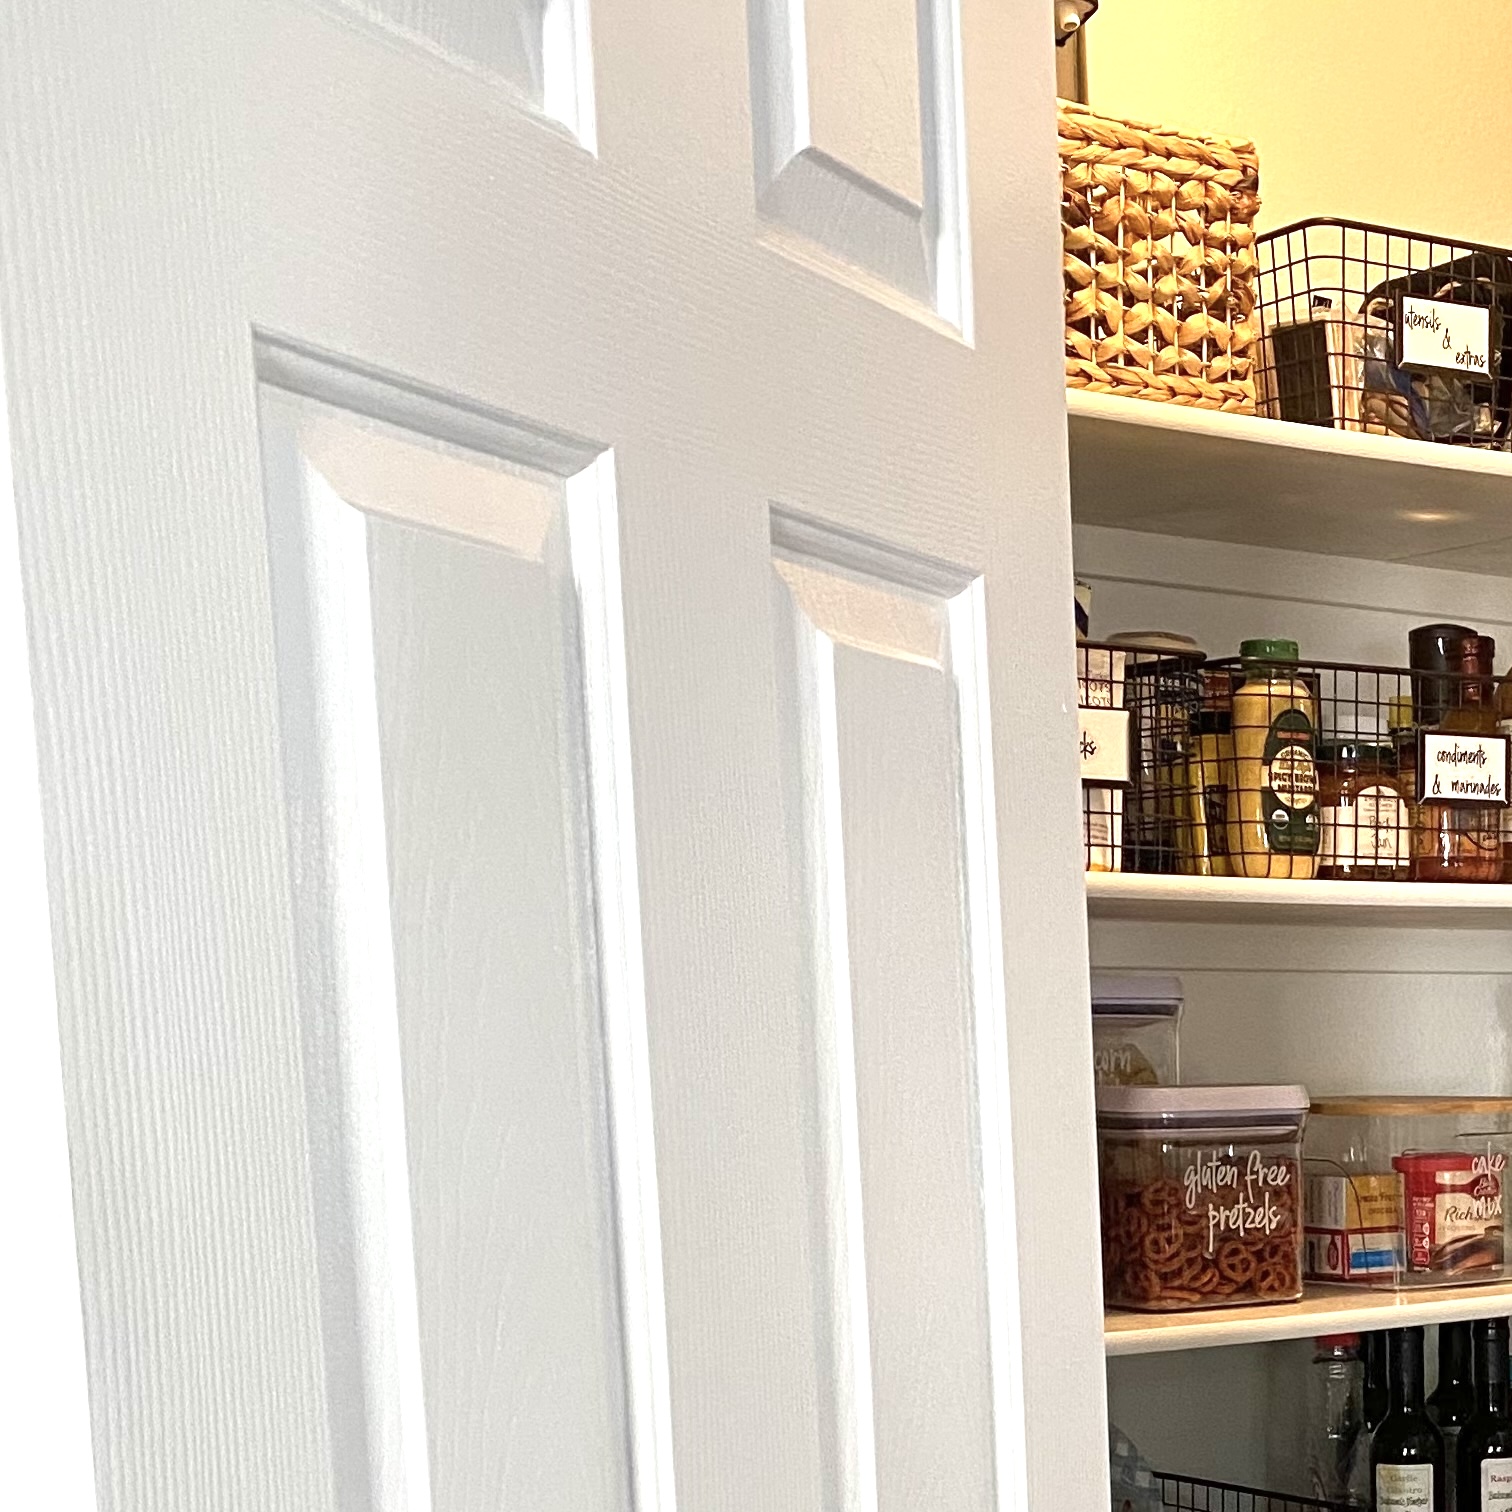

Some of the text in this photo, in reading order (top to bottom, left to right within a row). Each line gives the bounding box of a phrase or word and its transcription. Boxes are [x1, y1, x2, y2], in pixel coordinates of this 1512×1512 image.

[1404, 304, 1442, 334] utensils
[1442, 327, 1452, 350] &
[1455, 344, 1487, 369] extras
[1437, 742, 1488, 769] condiments
[1432, 773, 1442, 795] &
[1451, 774, 1502, 799] marinades
[1472, 1141, 1506, 1182] cake
[1183, 1149, 1291, 1210] gluten free
[1207, 1191, 1281, 1254] pretzels
